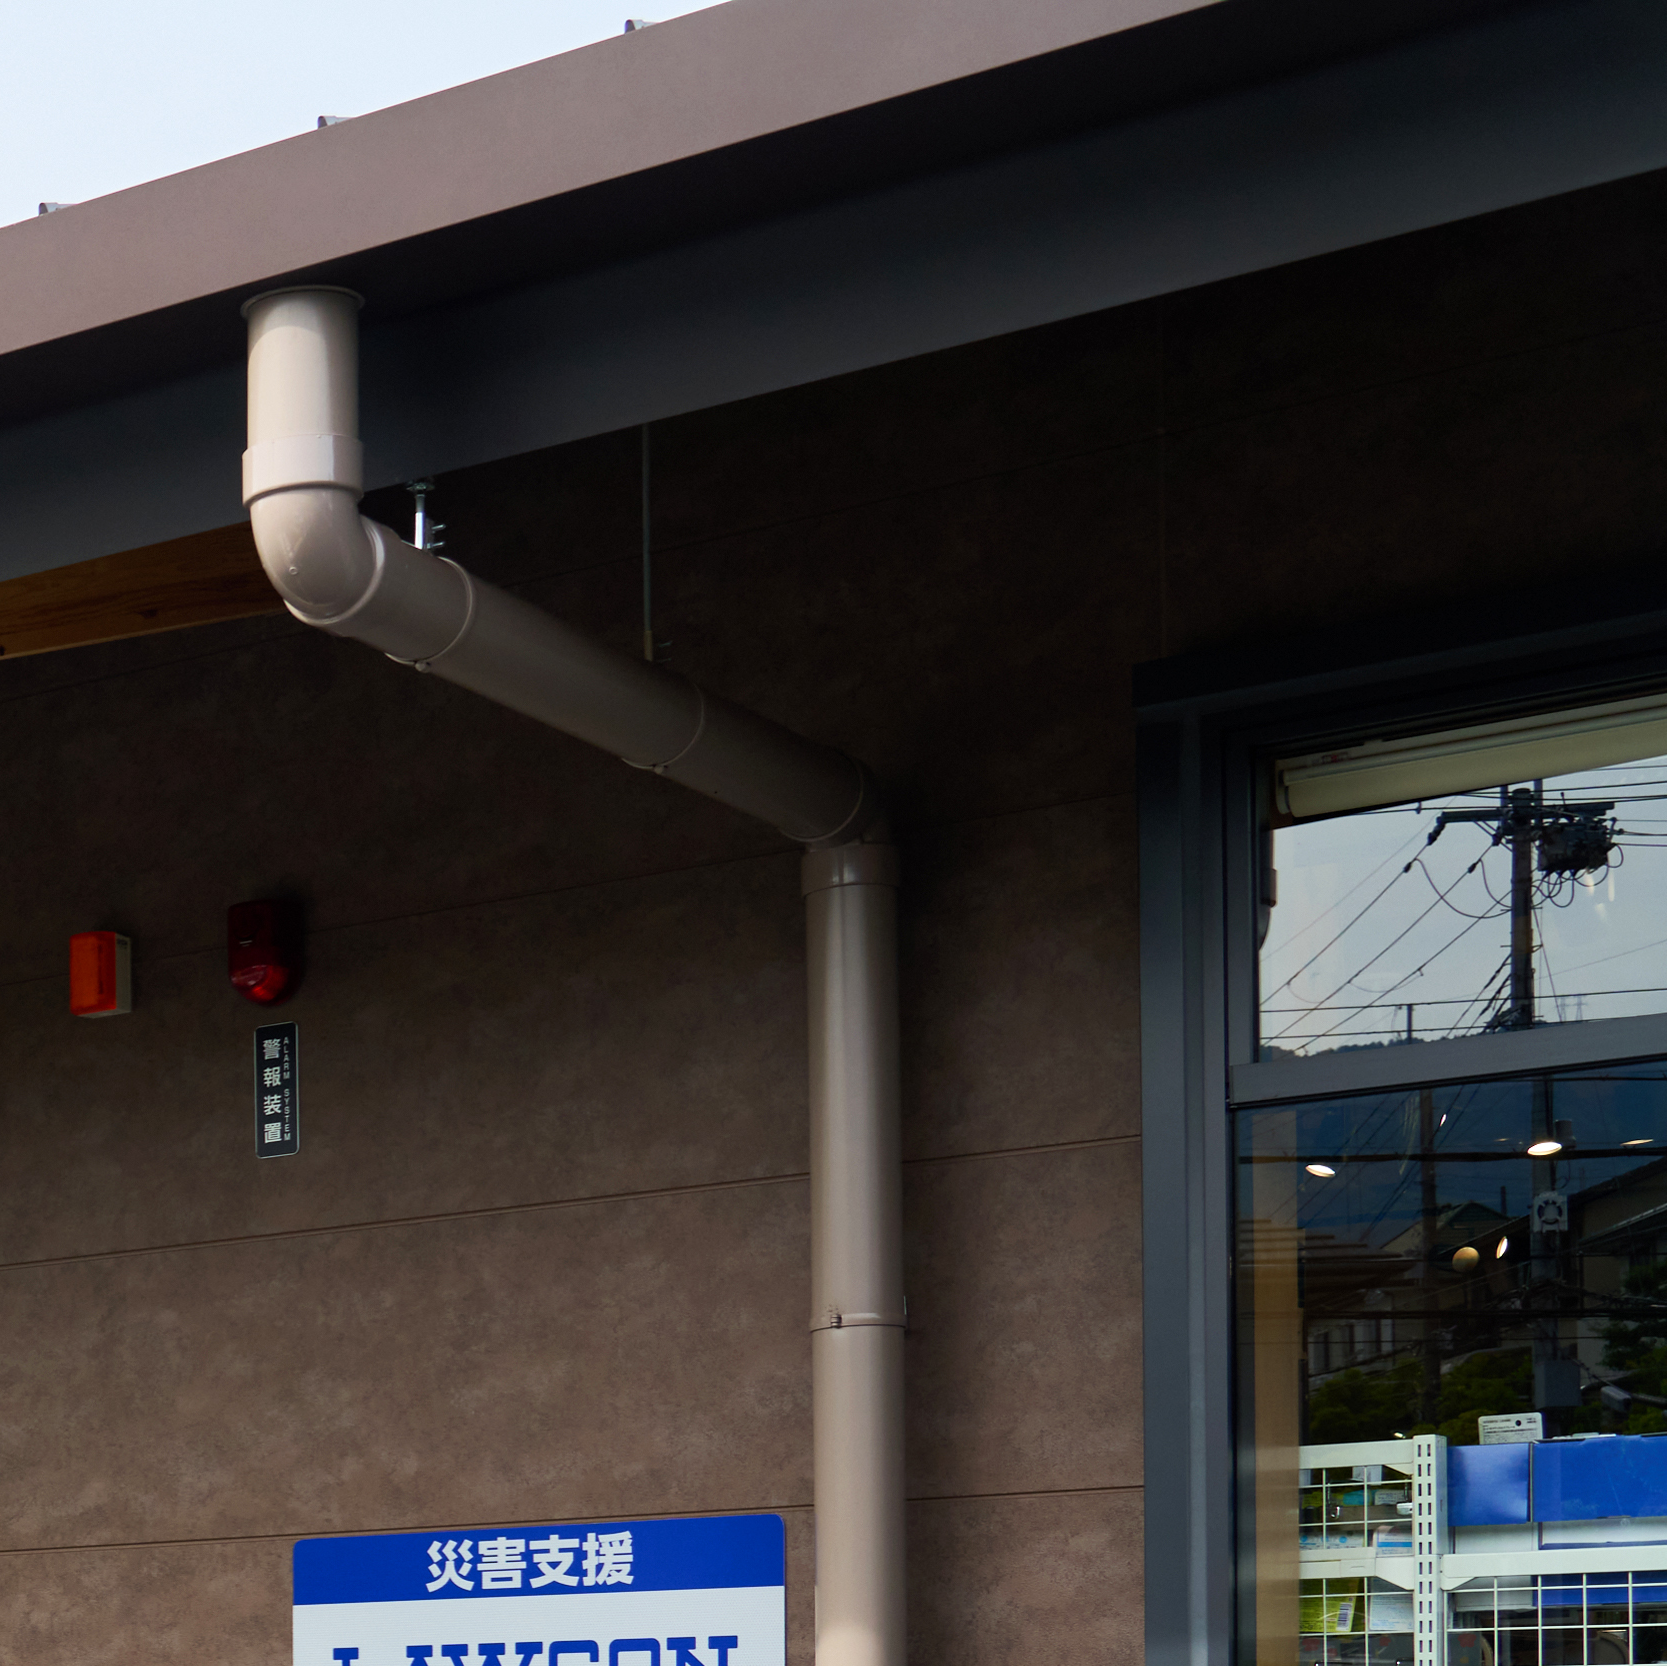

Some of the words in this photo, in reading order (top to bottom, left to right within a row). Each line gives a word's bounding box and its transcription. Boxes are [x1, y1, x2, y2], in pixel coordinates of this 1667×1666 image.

[262, 1038, 282, 1144] 警報装置
[425, 1530, 635, 1592] 災害支援
